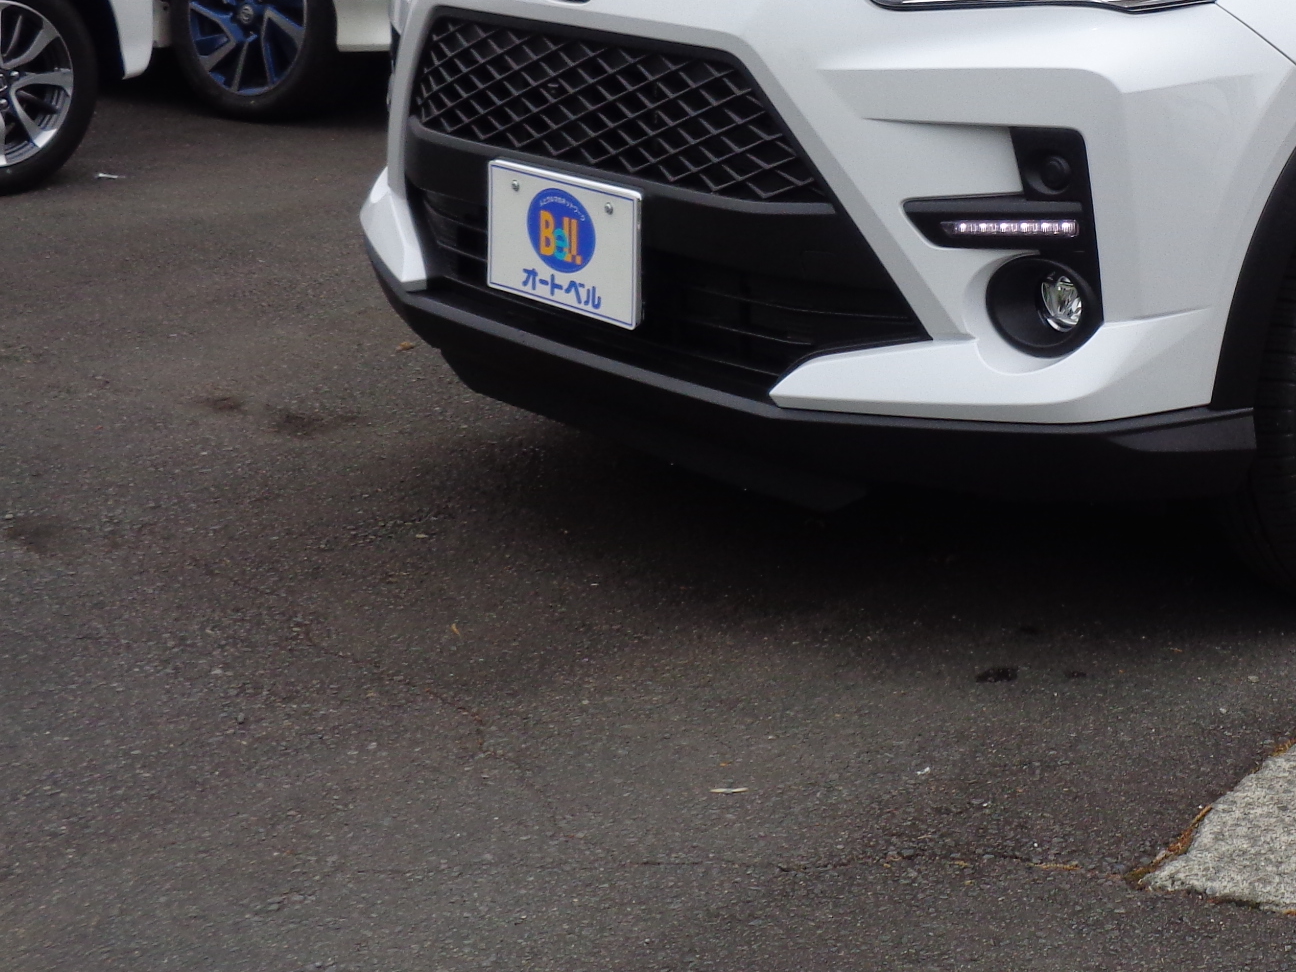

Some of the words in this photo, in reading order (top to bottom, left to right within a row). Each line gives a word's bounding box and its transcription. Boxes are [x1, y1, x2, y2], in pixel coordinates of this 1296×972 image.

[521, 267, 602, 310] オートベル
